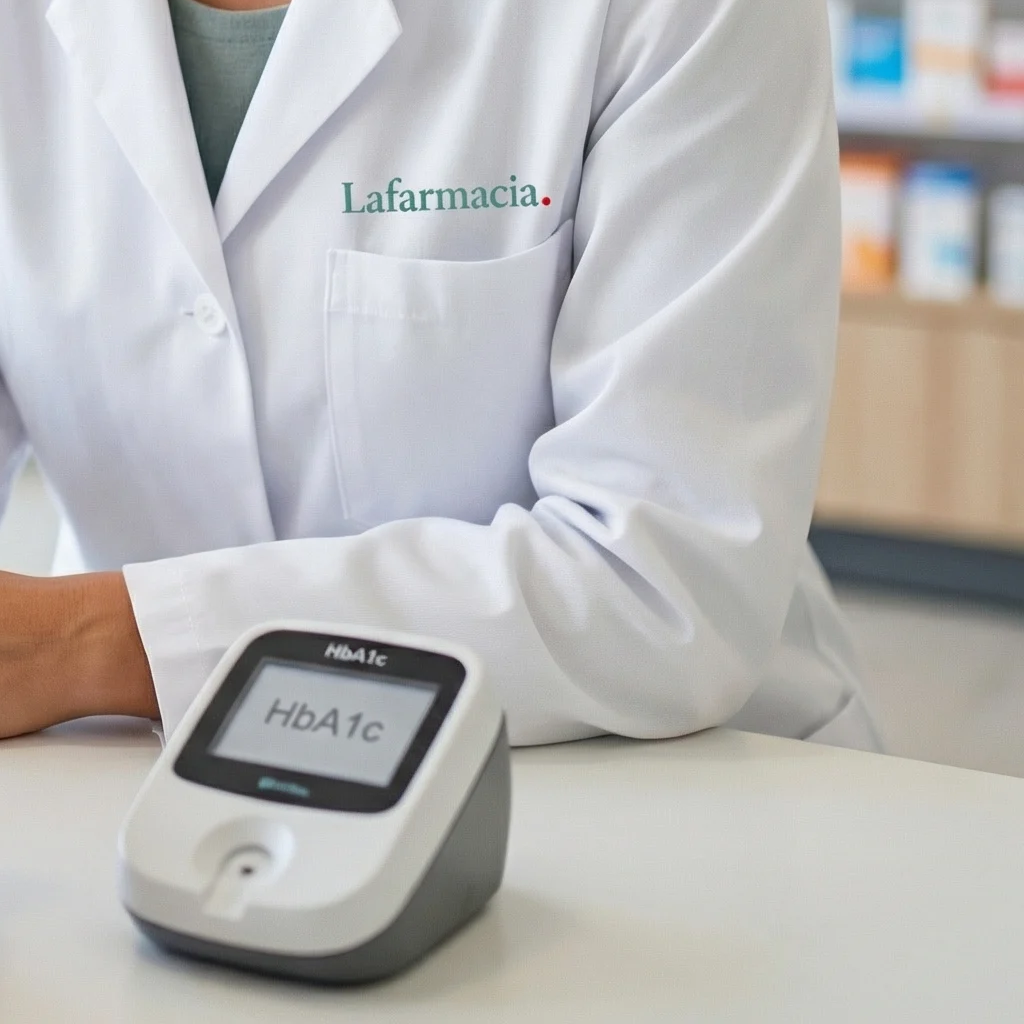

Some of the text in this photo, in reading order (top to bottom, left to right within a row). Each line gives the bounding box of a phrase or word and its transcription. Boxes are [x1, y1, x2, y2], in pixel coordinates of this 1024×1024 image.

[341, 175, 551, 214] Lafarmacia.
[324, 643, 388, 668] HbA1c
[264, 698, 385, 743] HbA1c
